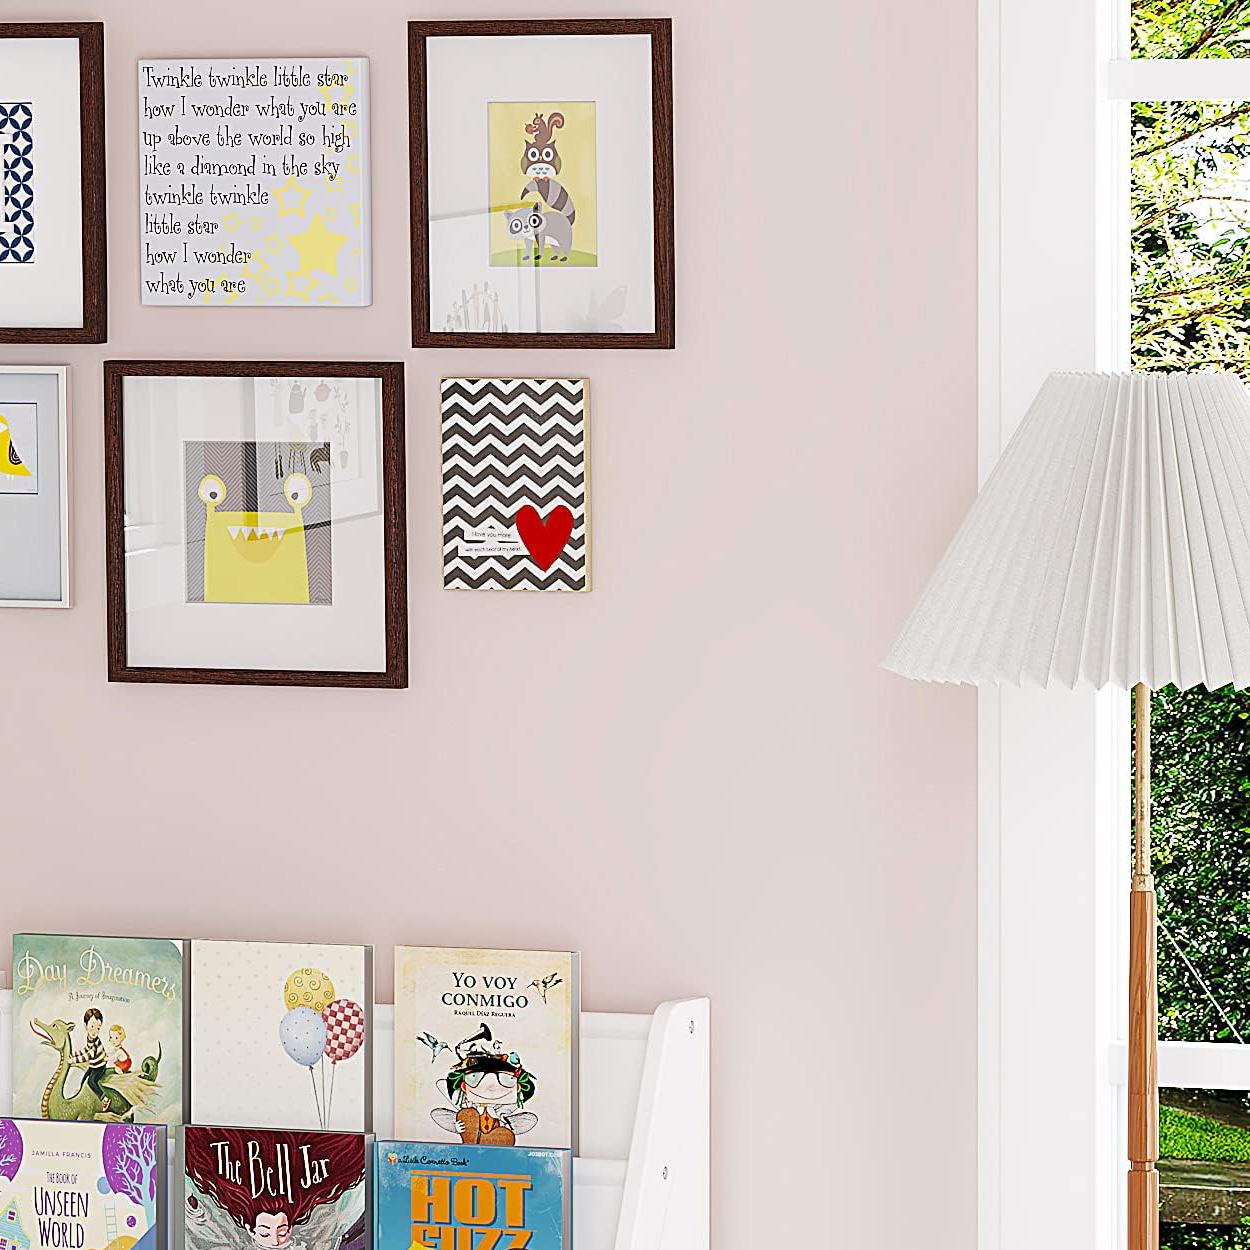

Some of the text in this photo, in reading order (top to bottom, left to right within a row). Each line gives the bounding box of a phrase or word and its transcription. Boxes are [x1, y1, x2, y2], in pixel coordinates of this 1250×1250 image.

[142, 65, 348, 88] Twinkle twinkle little star
[143, 95, 357, 122] how I wonder what you are
[142, 124, 350, 153] up above the world so high
[144, 154, 340, 181] like a diamond in the sky
[145, 183, 269, 206] twinkle twinkle
[145, 212, 219, 235] little star
[145, 242, 251, 265] how I wonder
[145, 271, 246, 299] what you are
[17, 944, 176, 1001] Day Dreamers
[452, 972, 517, 990] YO VOY
[441, 992, 529, 1009] CONMIGO
[31, 1150, 92, 1159] JAMILLA FRANCIS
[46, 1171, 78, 1185] THE BOOK OF
[210, 1140, 330, 1203] The Bell Jar
[34, 1186, 89, 1217] UNSEEN
[411, 1175, 532, 1228] HOT
[38, 1217, 85, 1248] WORLD
